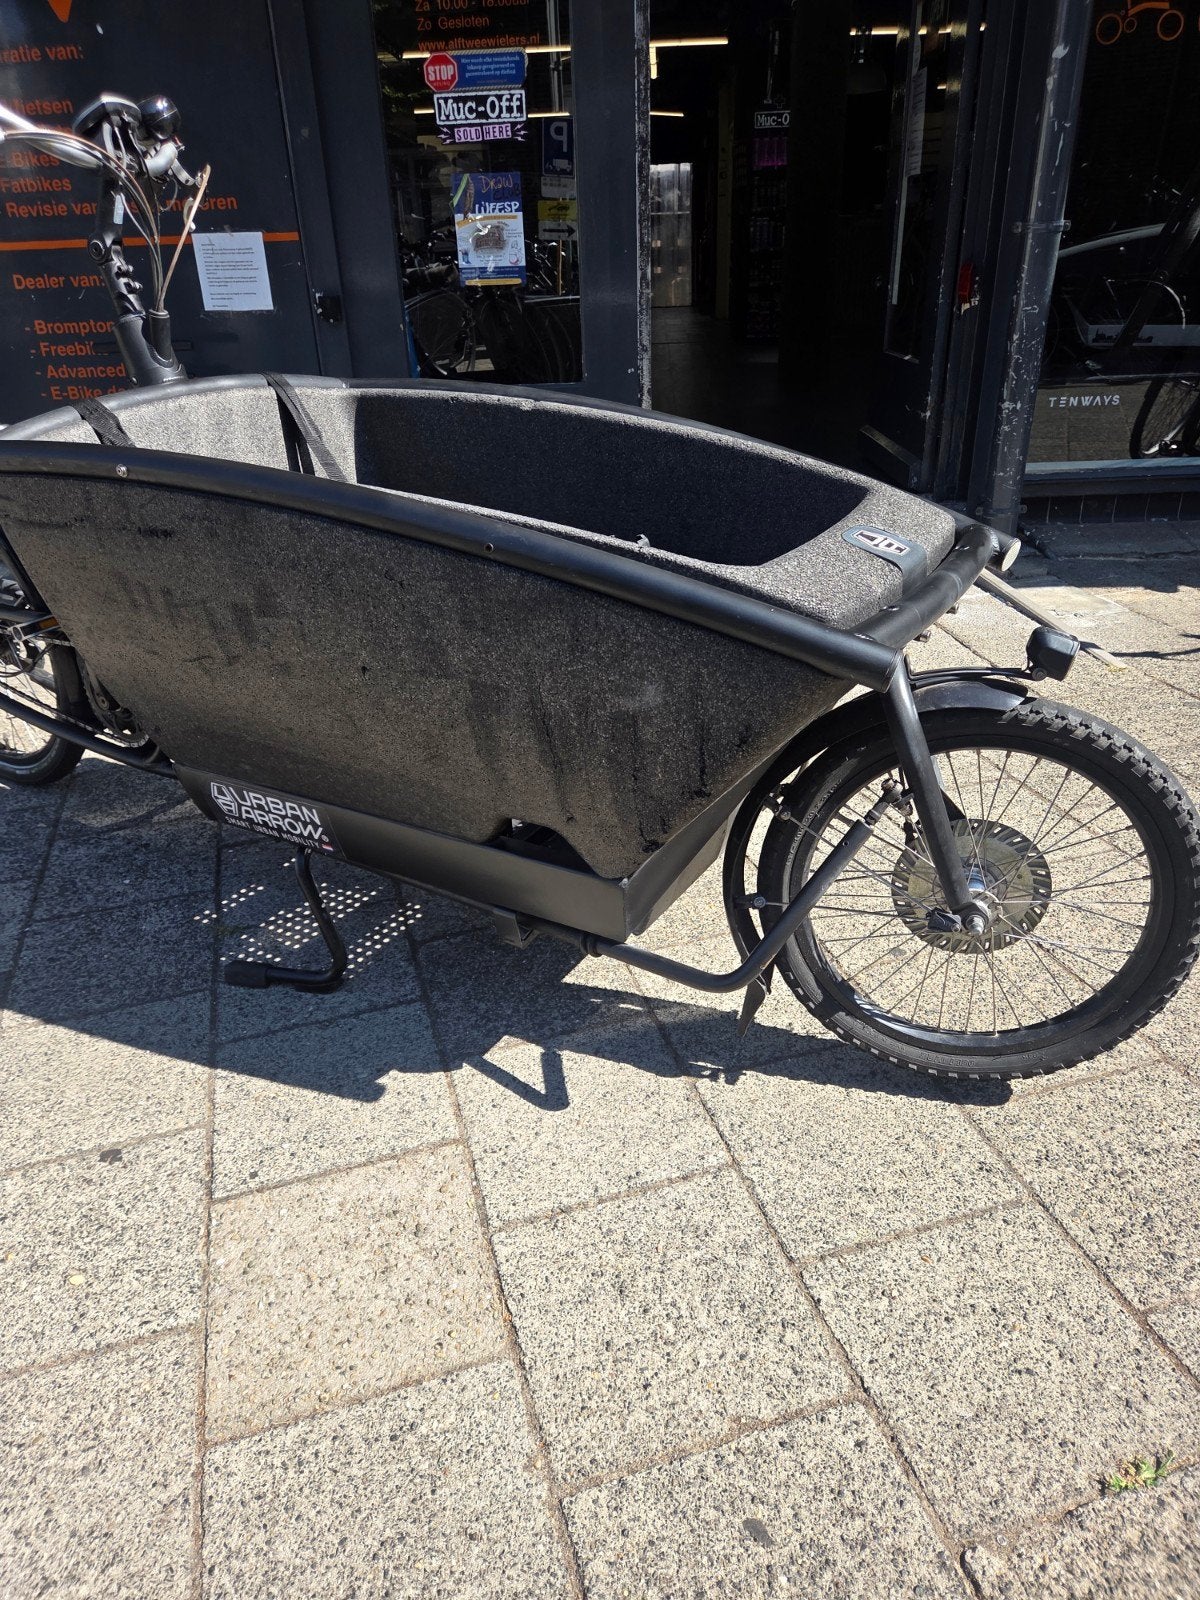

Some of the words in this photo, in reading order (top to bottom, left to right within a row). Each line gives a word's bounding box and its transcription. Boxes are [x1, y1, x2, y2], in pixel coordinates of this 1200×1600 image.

[415, 0, 430, 12] Za
[417, 18, 432, 31] Zo
[438, 16, 490, 30] Gesloten
[418, 33, 540, 51] www.alftweewielers.nl
[45, 44, 84, 60] van:
[427, 64, 455, 82] STOP
[438, 94, 522, 121] Muc-Off
[456, 128, 482, 141] SOLD
[485, 126, 511, 139] HERE
[0, 177, 72, 193] Fatbikes
[6, 200, 68, 218] Revisie
[475, 201, 520, 214] WEESP
[13, 274, 65, 290] Dealer
[70, 274, 106, 288] van:
[47, 363, 127, 379] Advanced
[51, 385, 102, 401] E-Bike
[1049, 395, 1120, 407] TENWAYS
[229, 786, 321, 826] URBAN
[241, 806, 324, 840] ARROW
[225, 816, 250, 829] SMART
[254, 824, 280, 838] URBAN
[281, 833, 320, 849] MOBILITY
